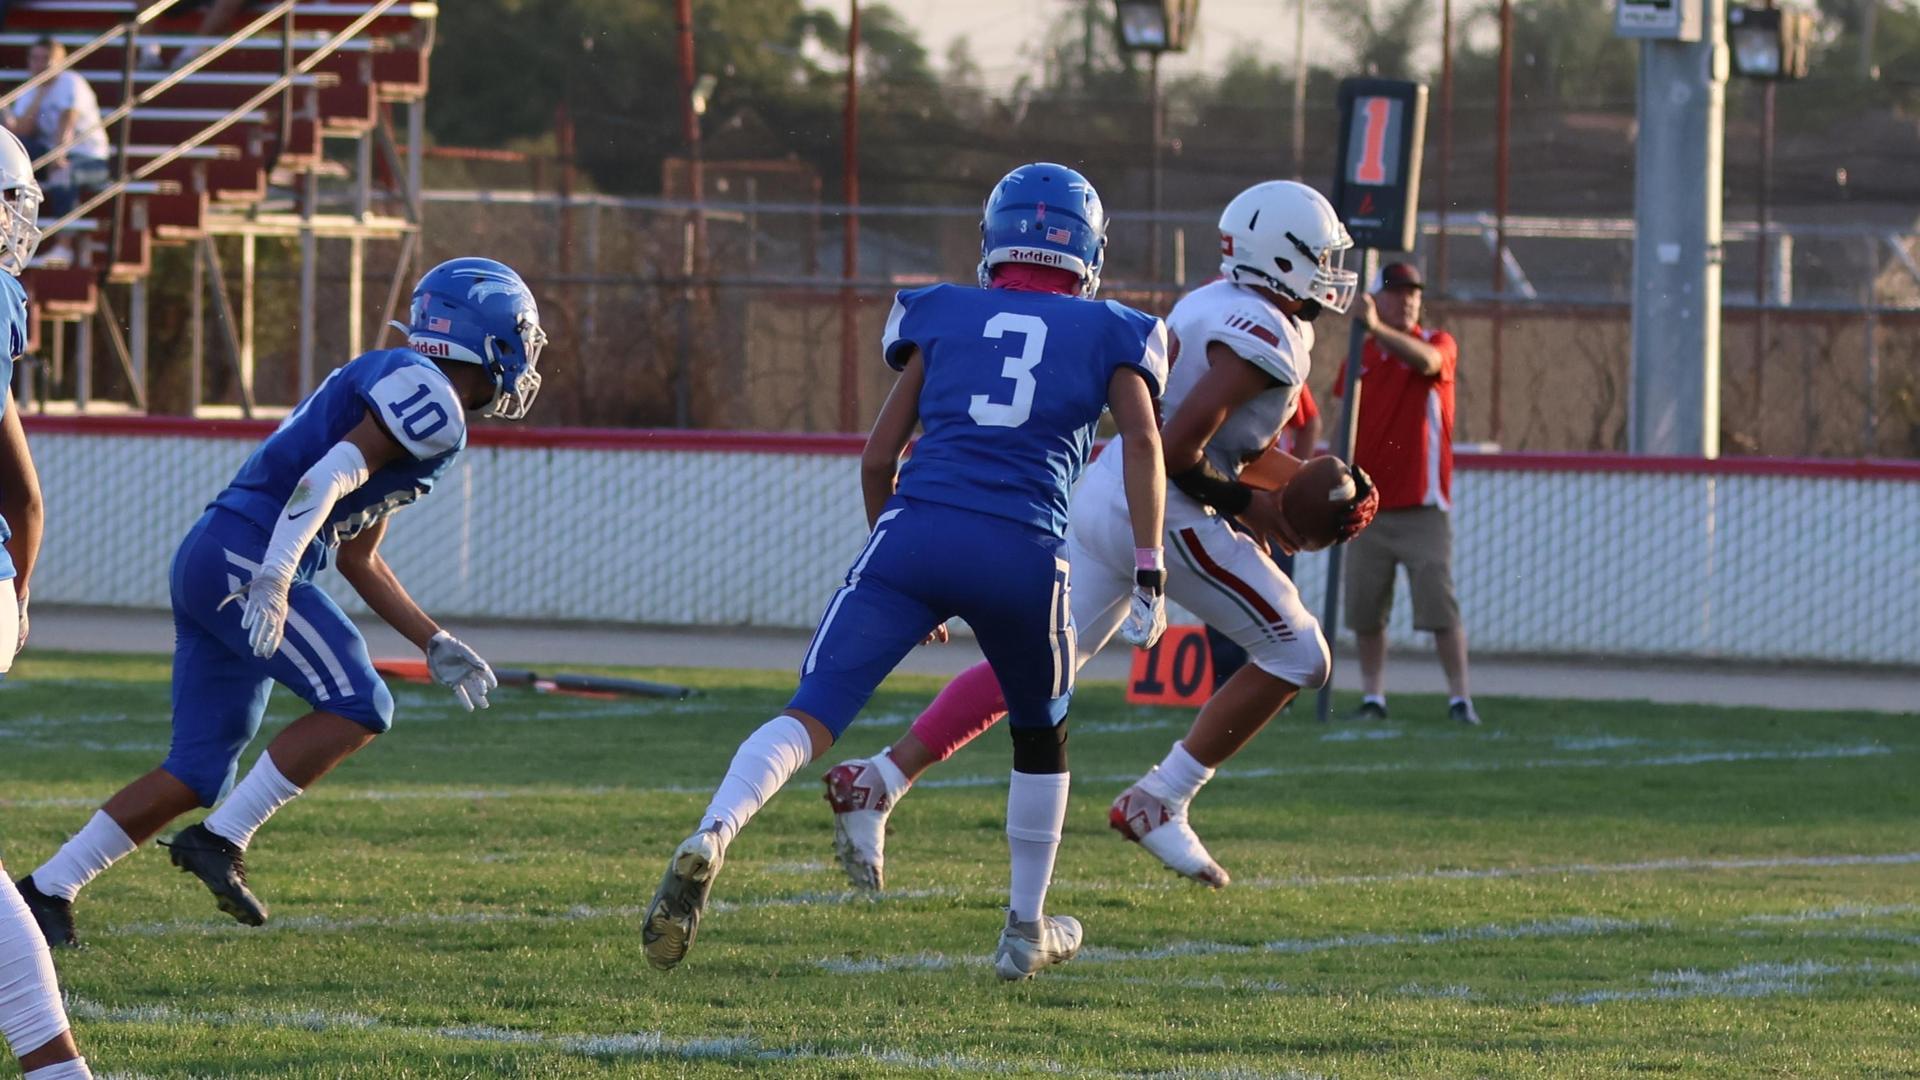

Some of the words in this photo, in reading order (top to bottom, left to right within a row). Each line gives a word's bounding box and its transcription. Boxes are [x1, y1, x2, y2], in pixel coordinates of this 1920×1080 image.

[1356, 95, 1391, 186] 1
[1020, 219, 1028, 233] 3
[1009, 249, 1062, 265] Riddell
[408, 341, 449, 357] ddell
[968, 312, 1048, 428] 3
[388, 383, 448, 441] 10
[1133, 632, 1206, 698] 10
